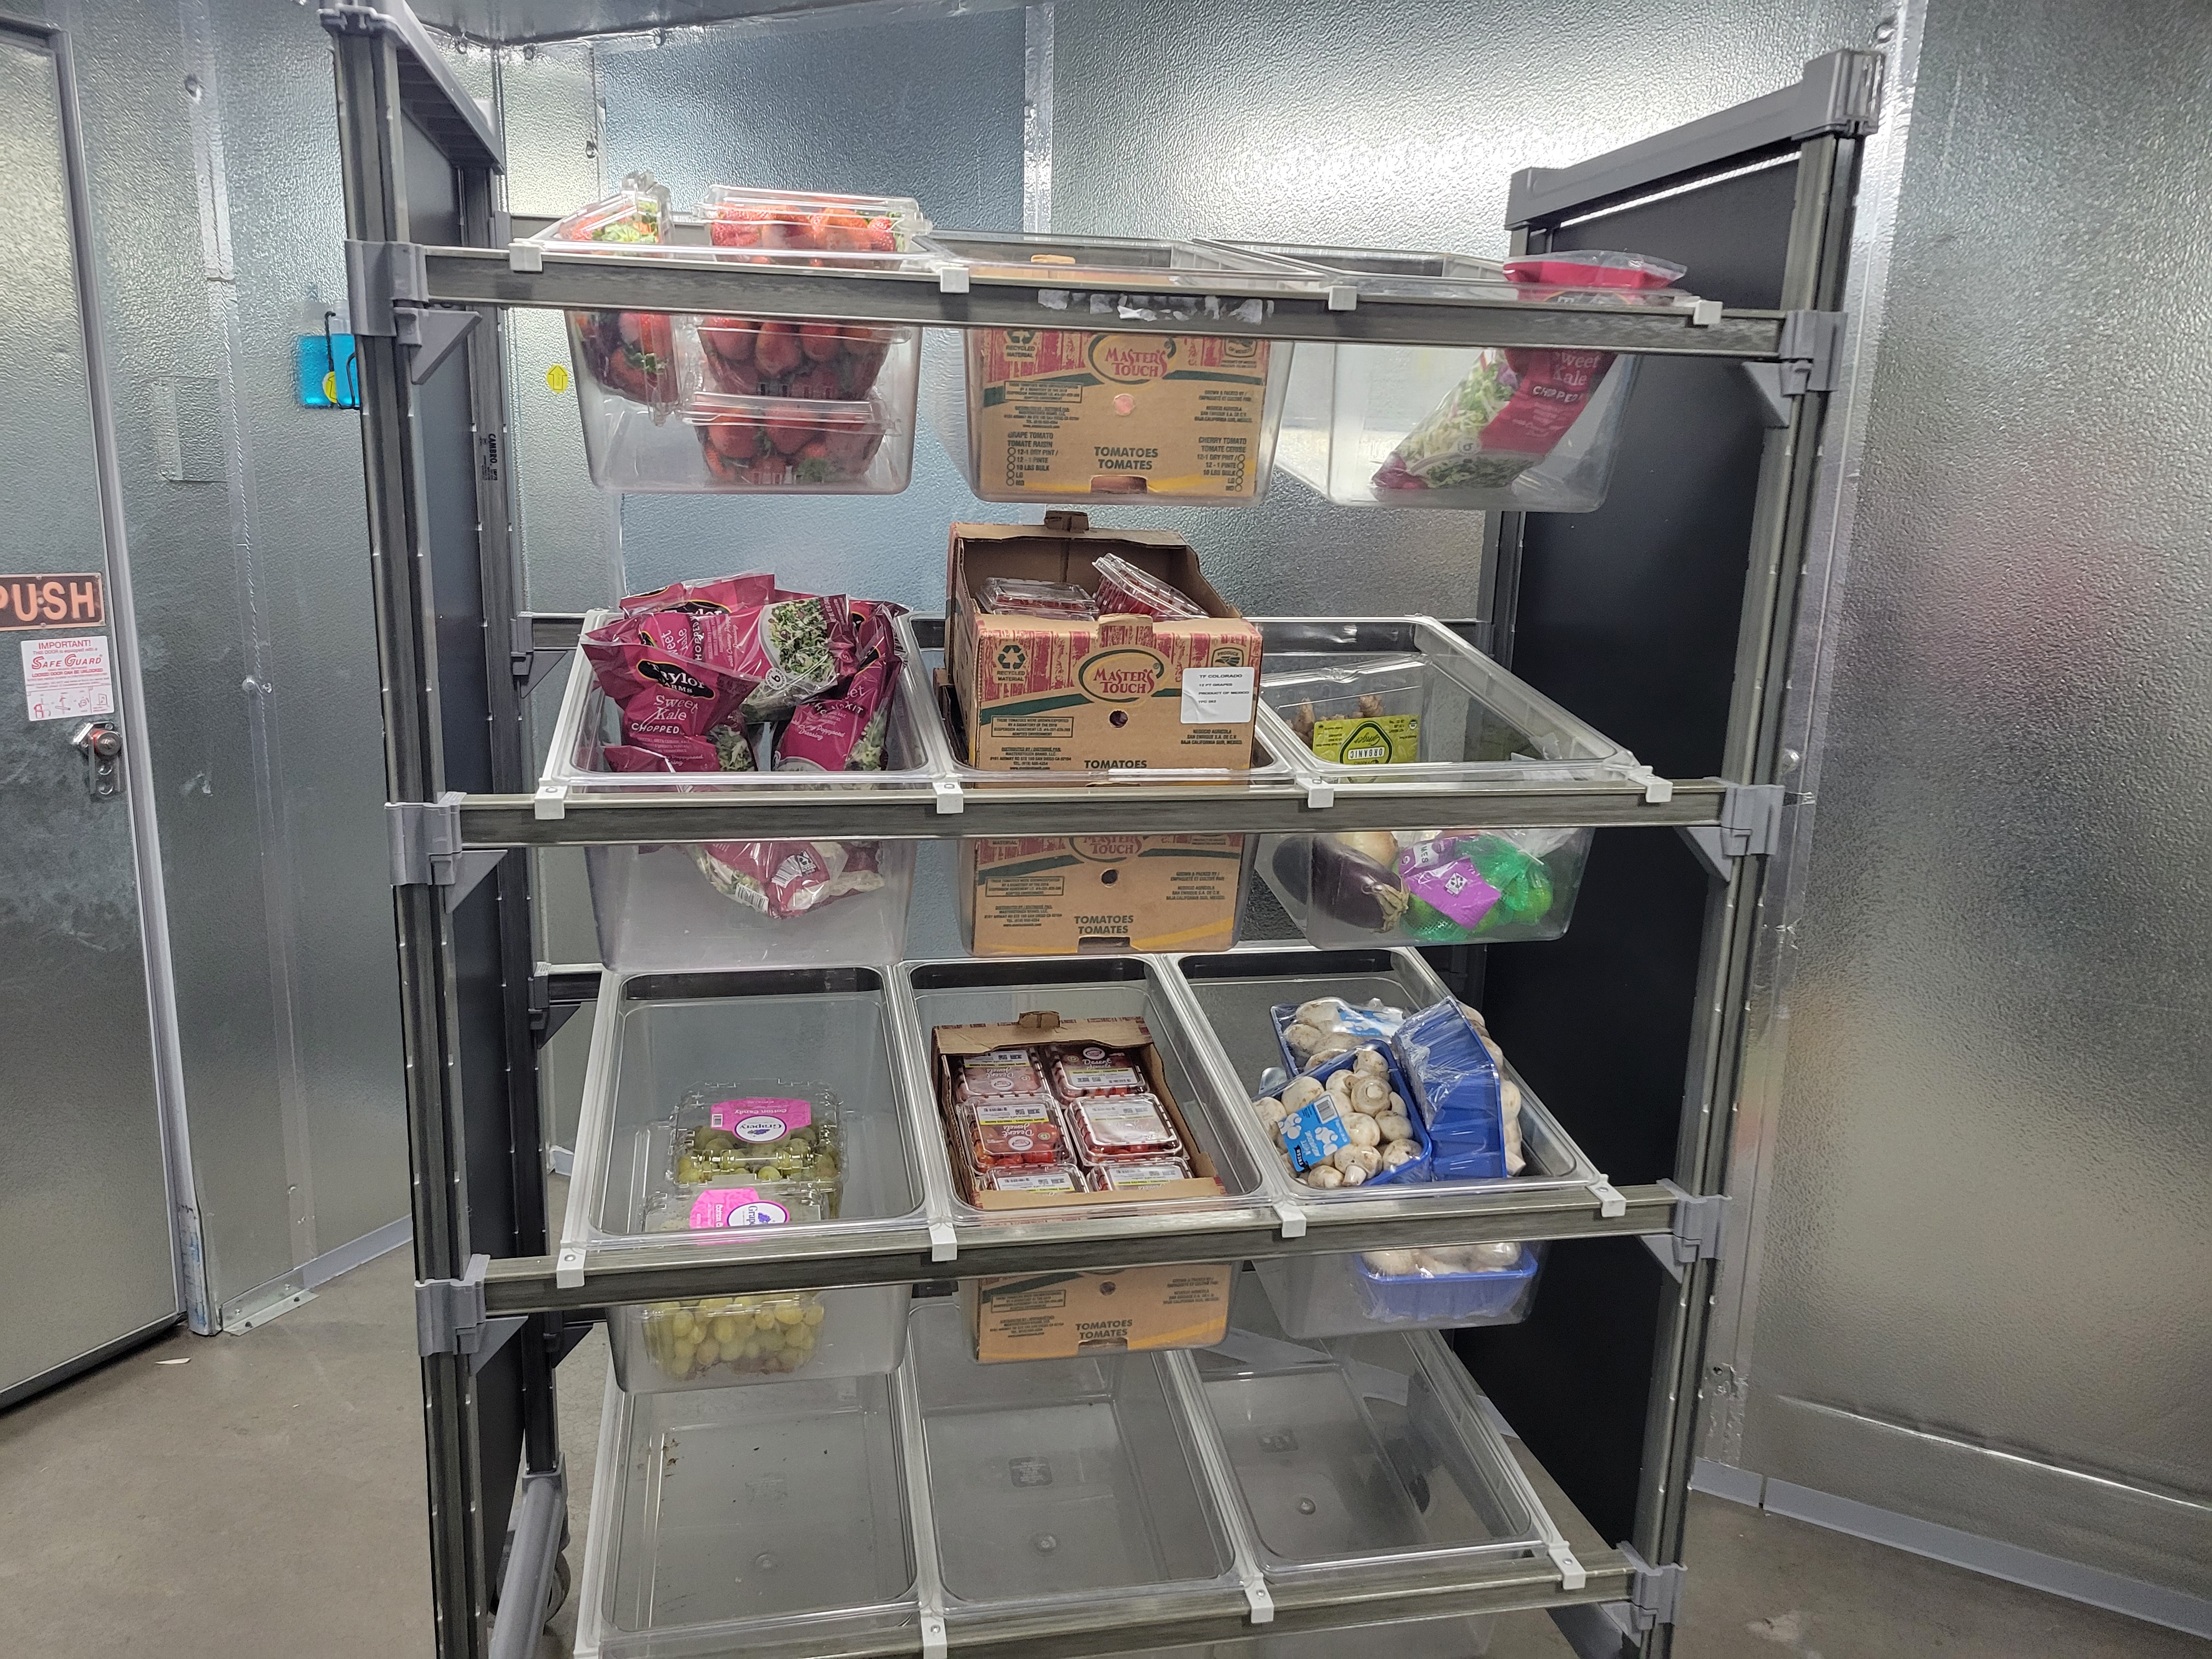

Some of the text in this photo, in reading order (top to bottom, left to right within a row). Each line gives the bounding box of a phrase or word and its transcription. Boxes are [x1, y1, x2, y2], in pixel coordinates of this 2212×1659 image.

[1104, 347, 1167, 376] MASTER'S
[1111, 363, 1159, 377] TOUCH
[488, 433, 498, 464] CAMBRO
[1094, 446, 1158, 458] TOMATOES
[1098, 459, 1152, 470] TOMATES
[38, 640, 91, 650] IMPORTANT!
[692, 622, 702, 661] HOPPED
[32, 654, 101, 669] SAFE GUARD
[661, 679, 692, 693] ARMS
[1093, 668, 1155, 692] MASTER'S
[1099, 681, 1146, 693] TOUCH
[654, 695, 698, 714] Sweet
[654, 707, 687, 720] Kale
[631, 722, 679, 735] CHOPPED
[798, 729, 823, 741] Dressing
[1354, 732, 1381, 746] Ginger
[1350, 748, 1383, 759] ORGANIC
[1085, 760, 1147, 769] TOMATOES
[1090, 843, 1133, 854] TOUCH
[1420, 845, 1429, 863] MES
[1074, 915, 1134, 924] TOMATOES
[1079, 926, 1128, 934] TOMATES
[1002, 1129, 1034, 1138] Desert
[746, 1206, 758, 1225] Grap
[1075, 1319, 1132, 1331] TOMATOES
[1080, 1329, 1127, 1339] TOMATES
